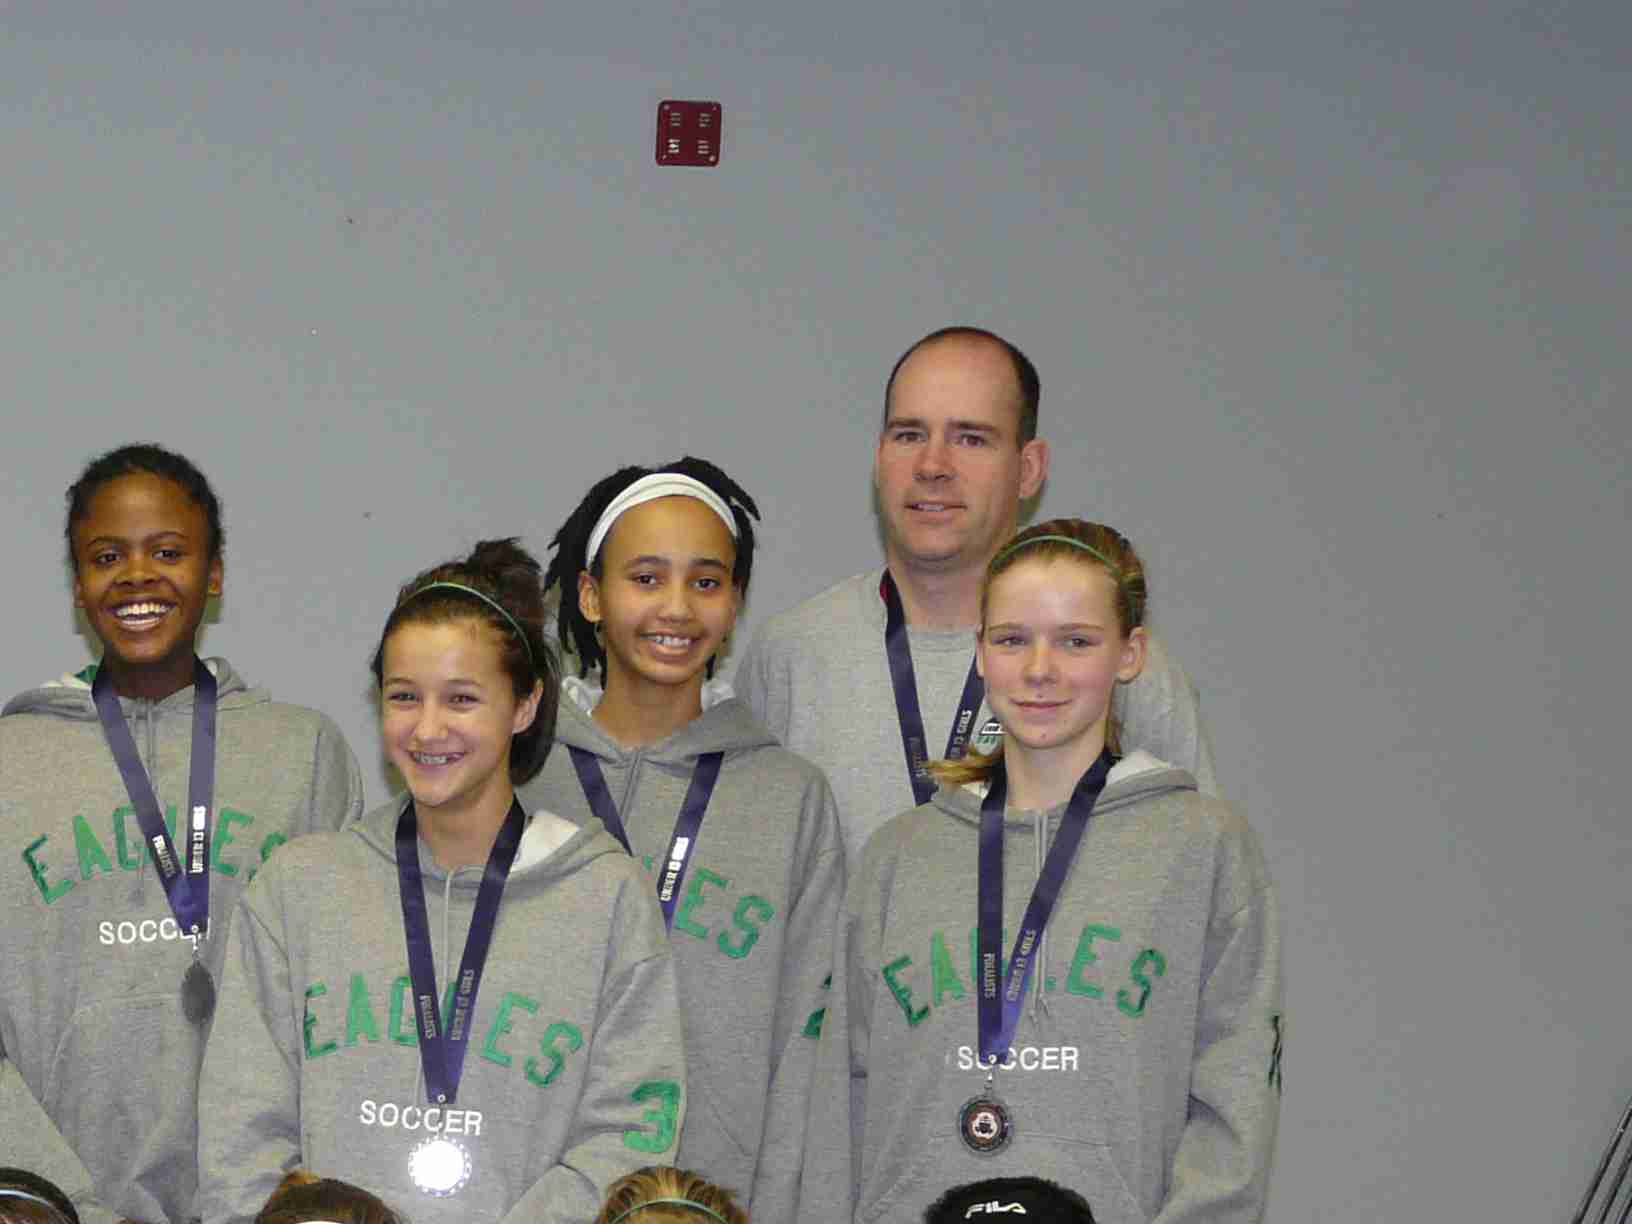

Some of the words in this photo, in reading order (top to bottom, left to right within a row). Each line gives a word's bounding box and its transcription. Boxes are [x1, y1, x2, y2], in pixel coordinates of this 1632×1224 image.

[98, 917, 211, 945] SOCC
[956, 1045, 1080, 1072] SCCER
[359, 1100, 483, 1137] SOCCER
[622, 1079, 681, 1153] 3
[964, 1200, 1027, 1219] FILA
